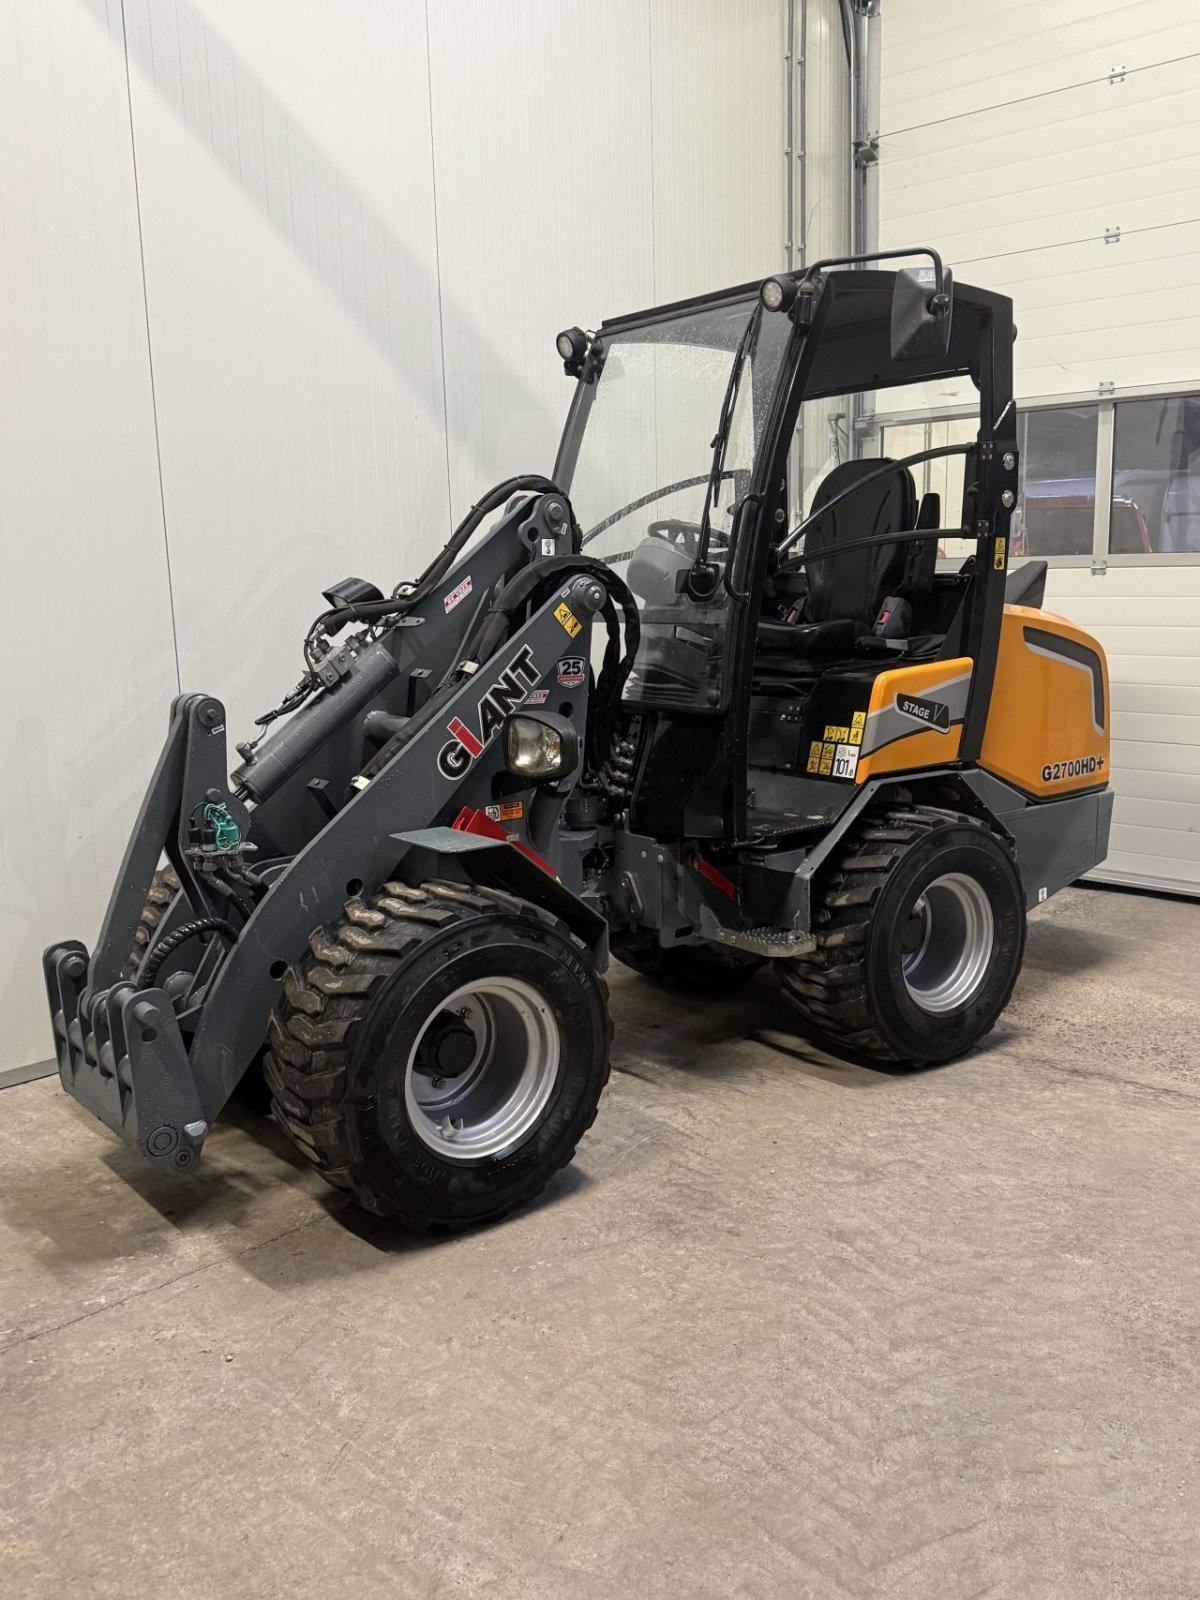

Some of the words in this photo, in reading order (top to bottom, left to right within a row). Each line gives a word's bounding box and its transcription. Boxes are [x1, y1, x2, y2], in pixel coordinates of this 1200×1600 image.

[562, 661, 581, 675] 25
[903, 701, 930, 719] STAGE
[932, 704, 946, 722] V
[835, 758, 850, 775] 101
[1041, 755, 1104, 782] G2700HD+
